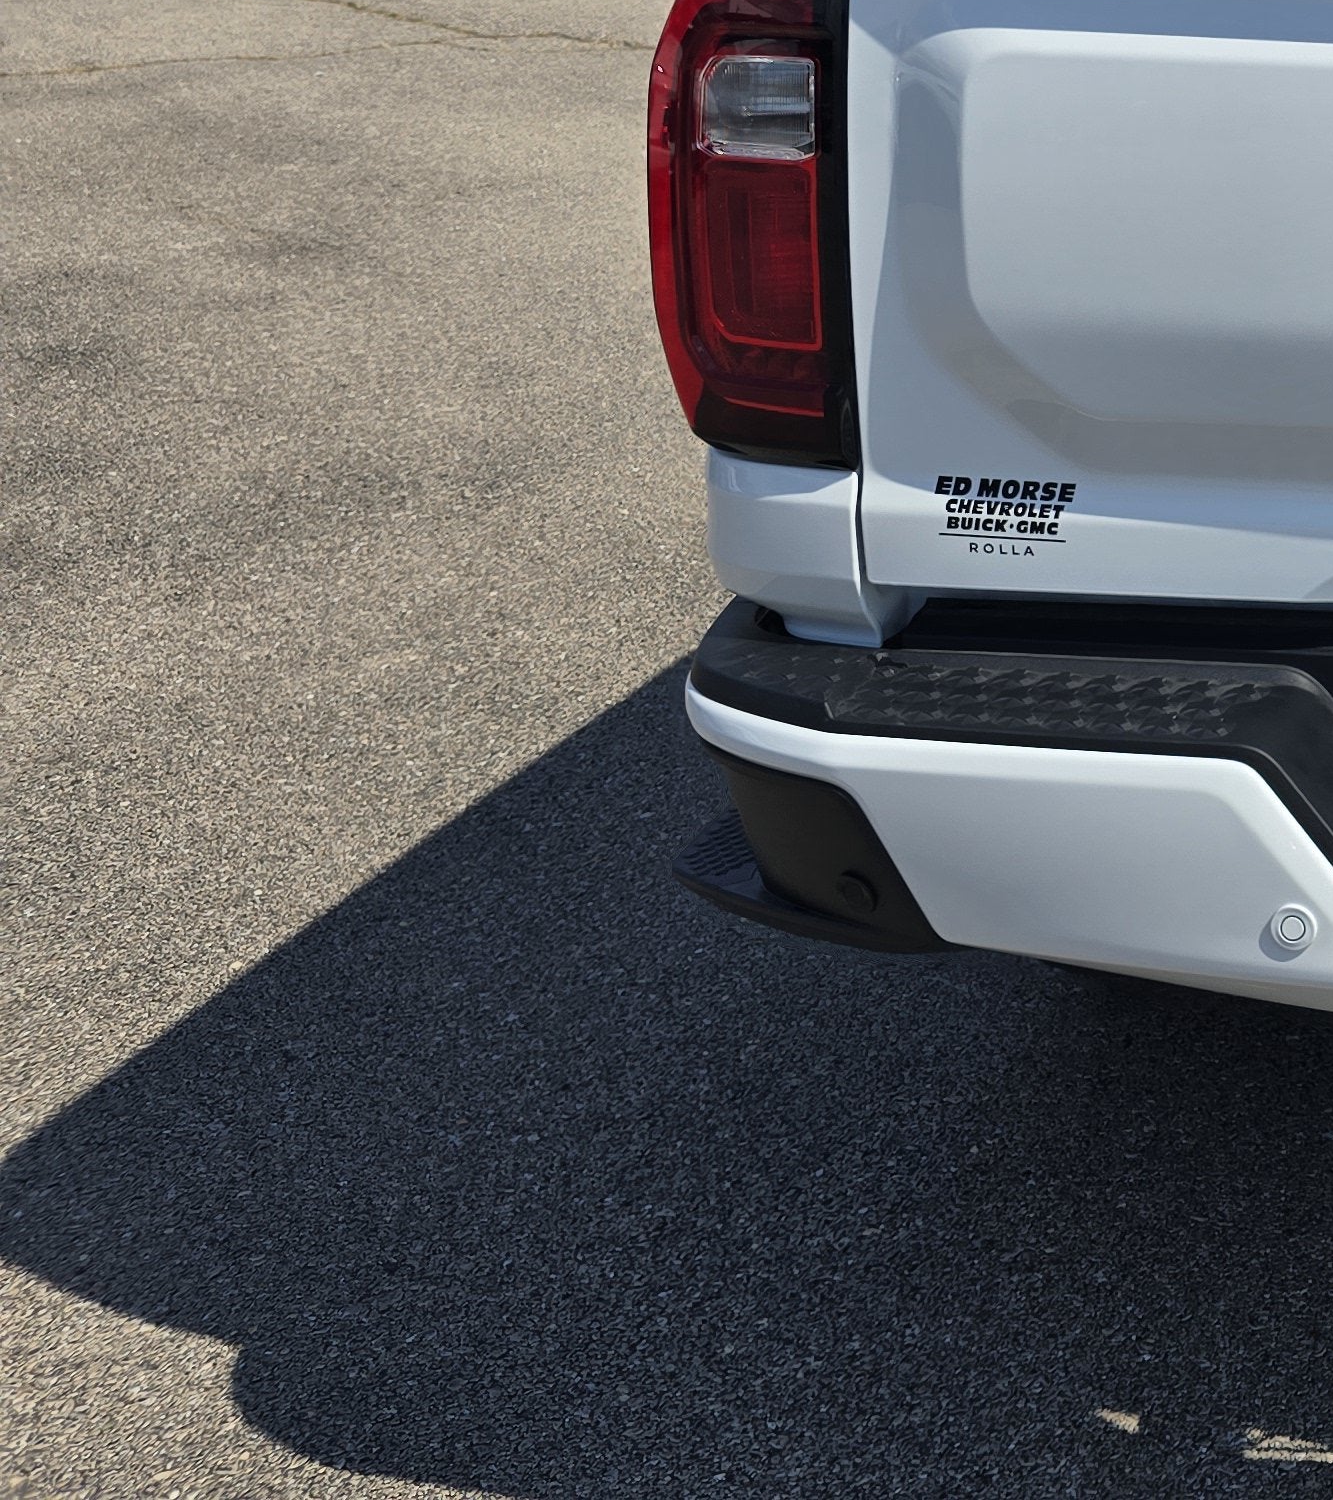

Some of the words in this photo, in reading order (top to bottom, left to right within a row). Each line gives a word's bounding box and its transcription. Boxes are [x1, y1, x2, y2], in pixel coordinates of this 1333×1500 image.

[934, 475, 972, 496] ED
[976, 478, 1076, 503] MORSE
[945, 499, 1065, 519] CHEVROLET
[969, 542, 1035, 556] ROLLA
